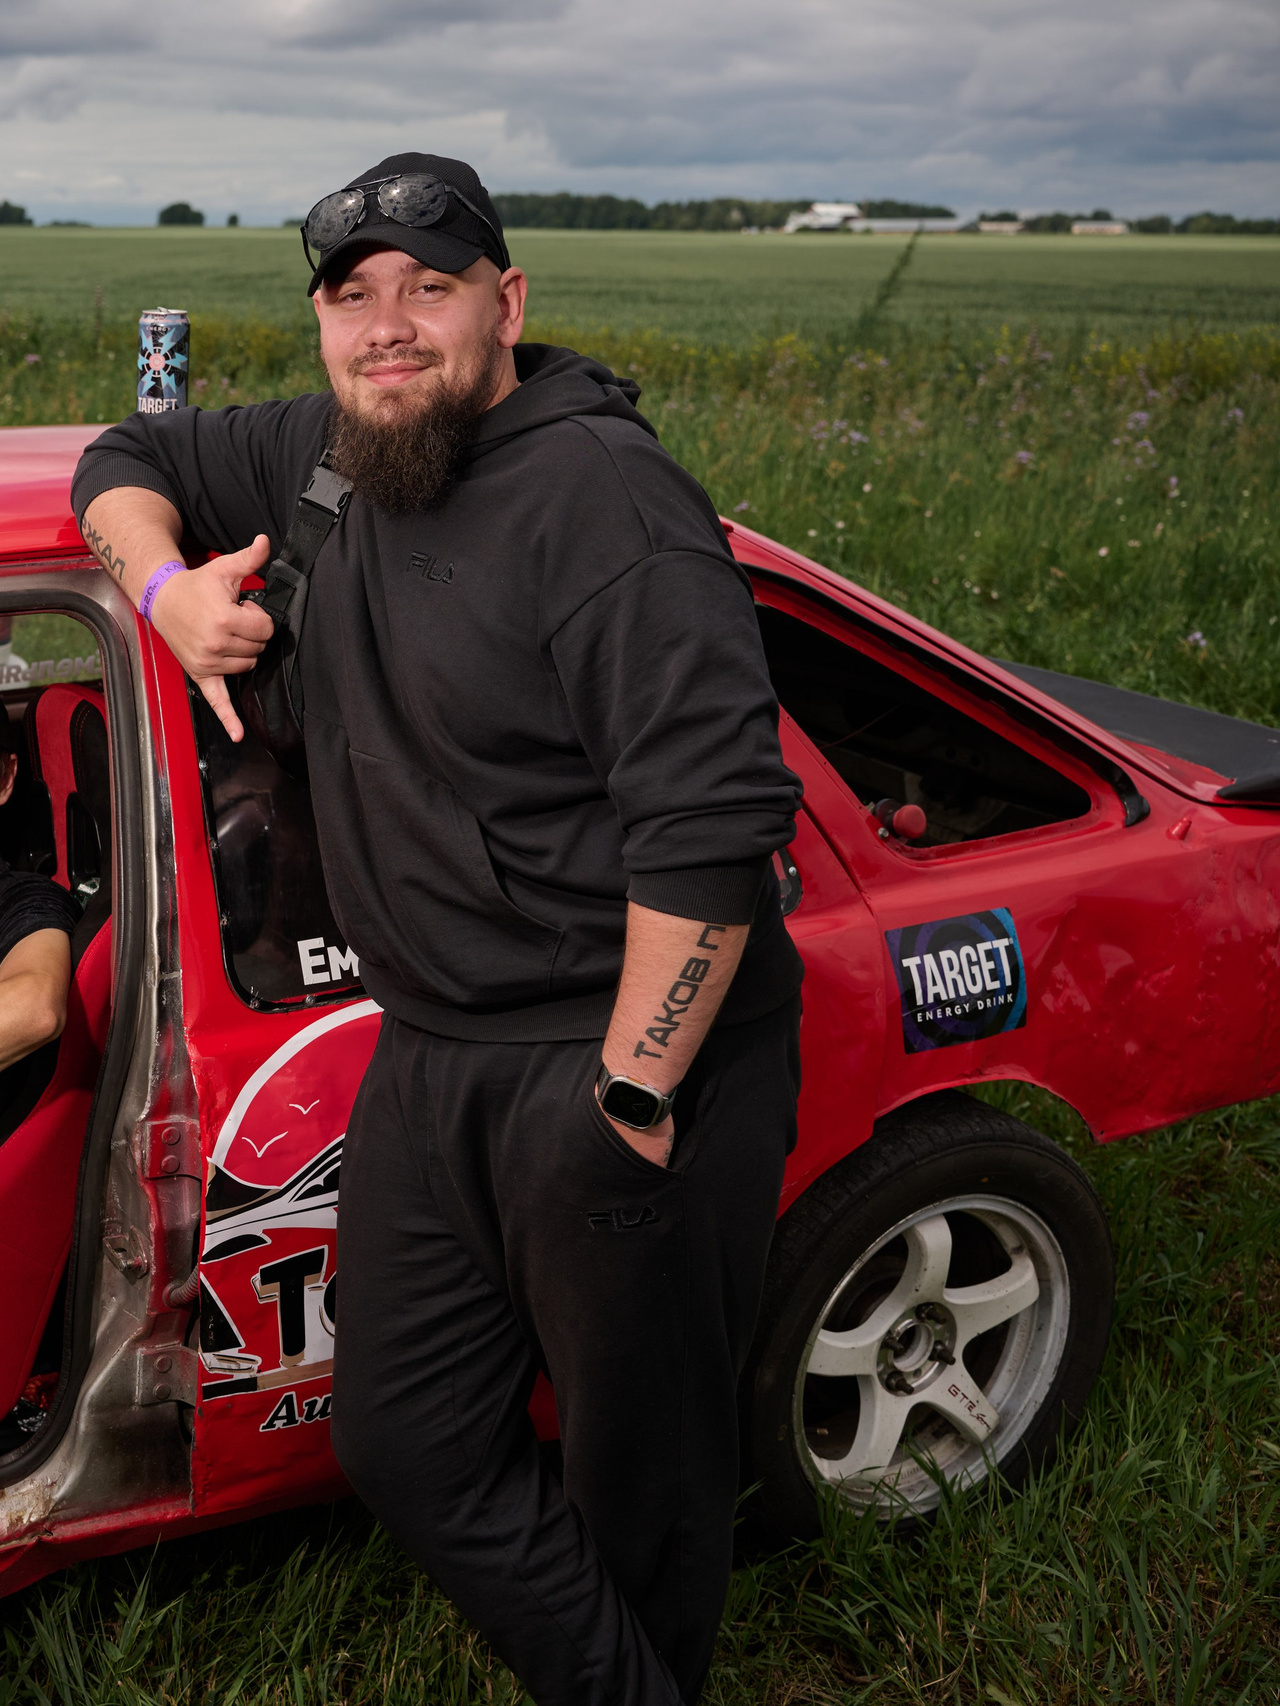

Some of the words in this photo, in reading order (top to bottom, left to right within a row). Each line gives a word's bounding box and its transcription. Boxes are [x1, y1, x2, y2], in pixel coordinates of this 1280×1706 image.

[406, 551, 457, 585] FILA
[901, 937, 1013, 1007] TARGET
[633, 956, 711, 1059] ТАКОВ
[696, 924, 728, 951] П
[917, 1003, 971, 1023] ENERGY
[977, 992, 1015, 1011] DRINK
[585, 1204, 660, 1233] FILA
